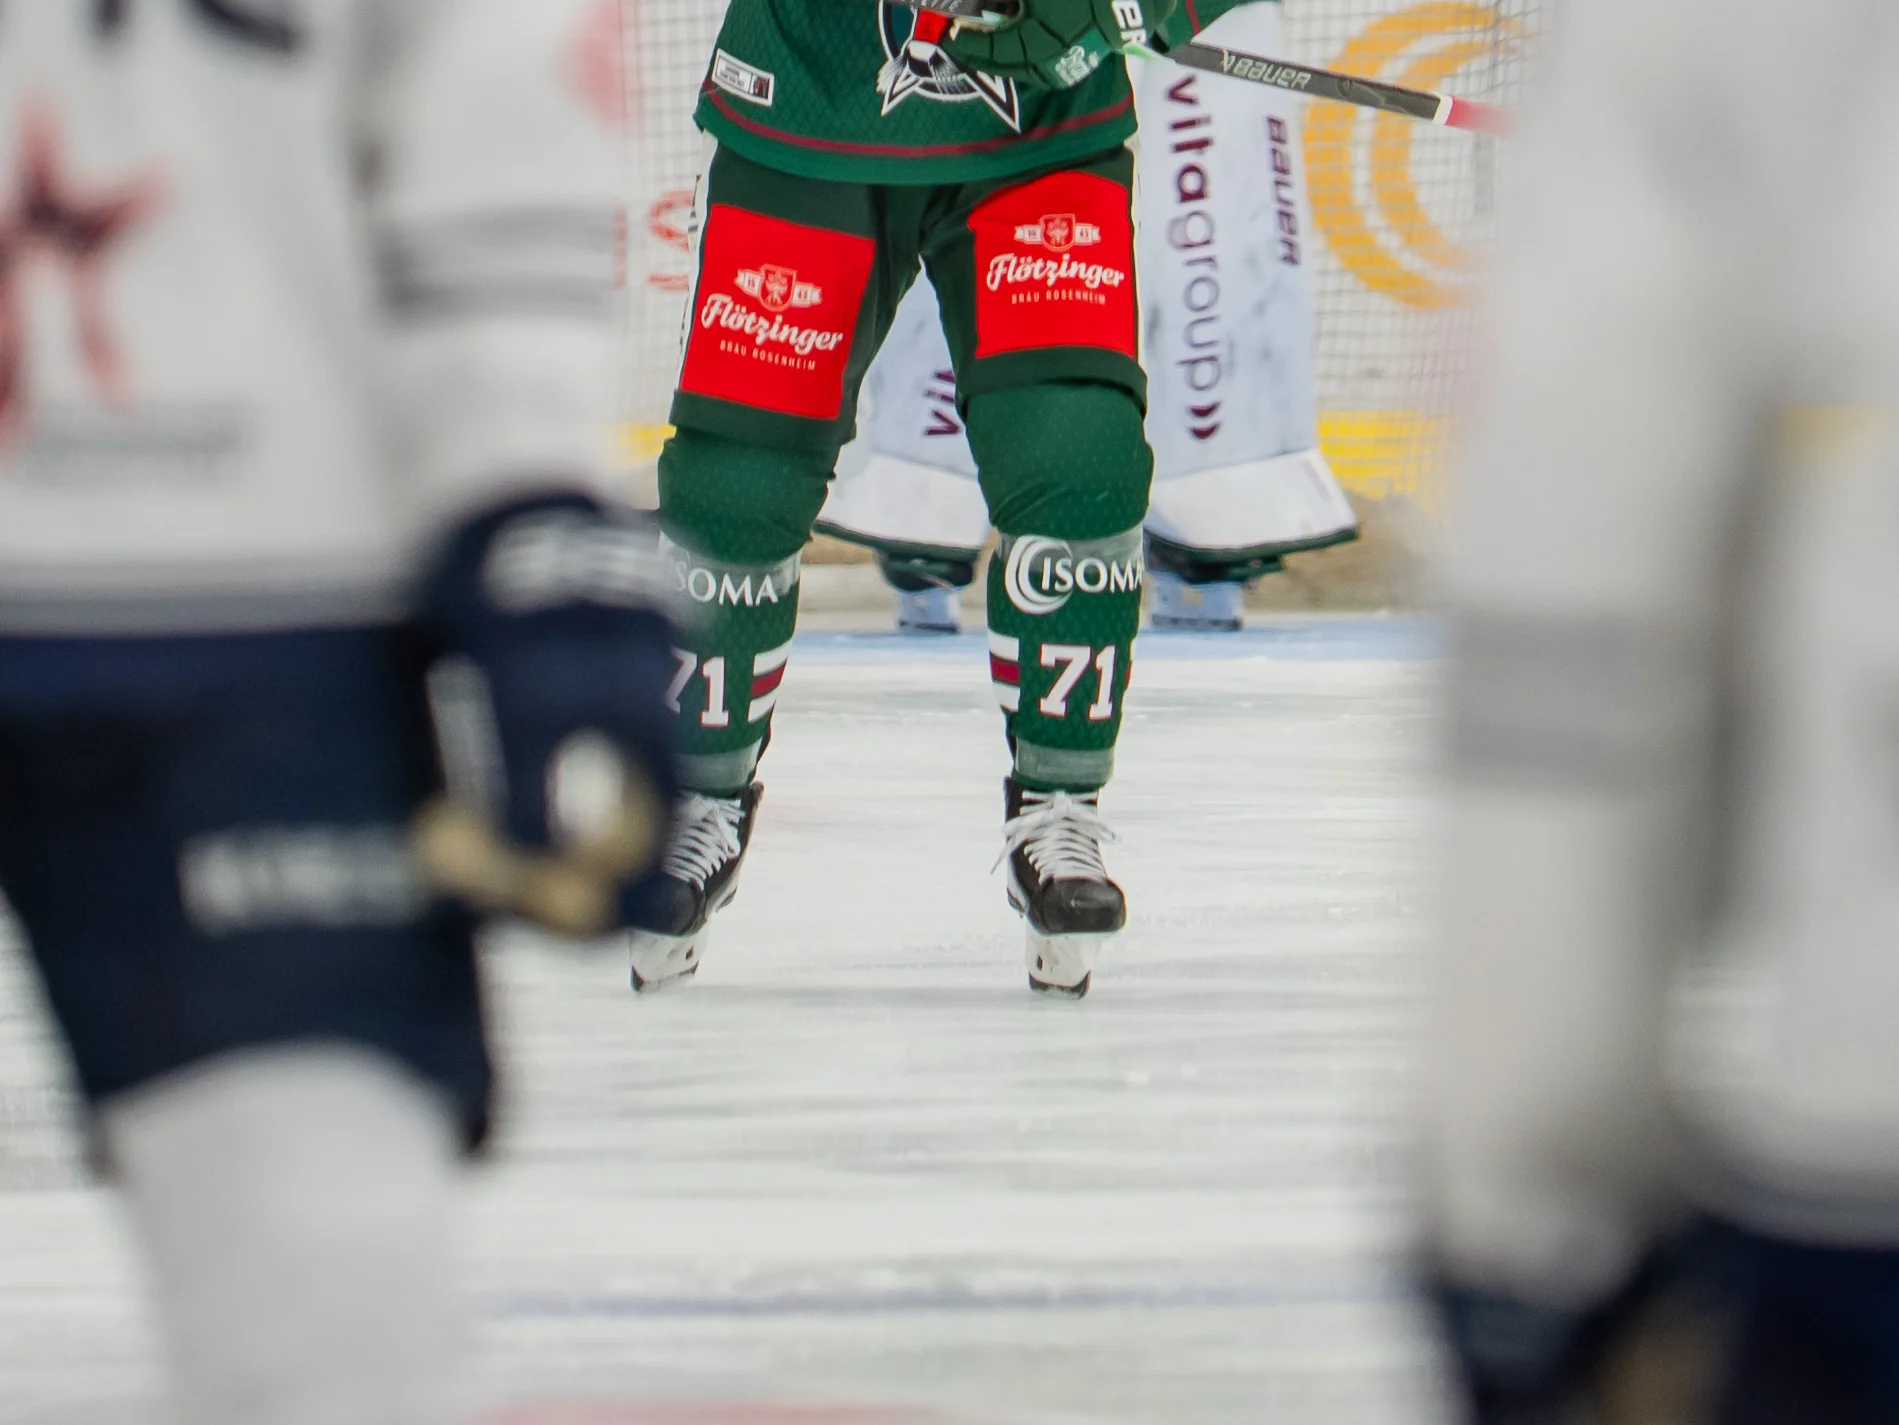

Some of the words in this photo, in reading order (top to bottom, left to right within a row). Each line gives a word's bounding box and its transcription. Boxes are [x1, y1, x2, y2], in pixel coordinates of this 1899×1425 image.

[986, 252, 1125, 292] Flötzinger
[701, 292, 844, 356] Flötzinger
[664, 644, 730, 727] 71
[1038, 643, 1118, 721] 71
